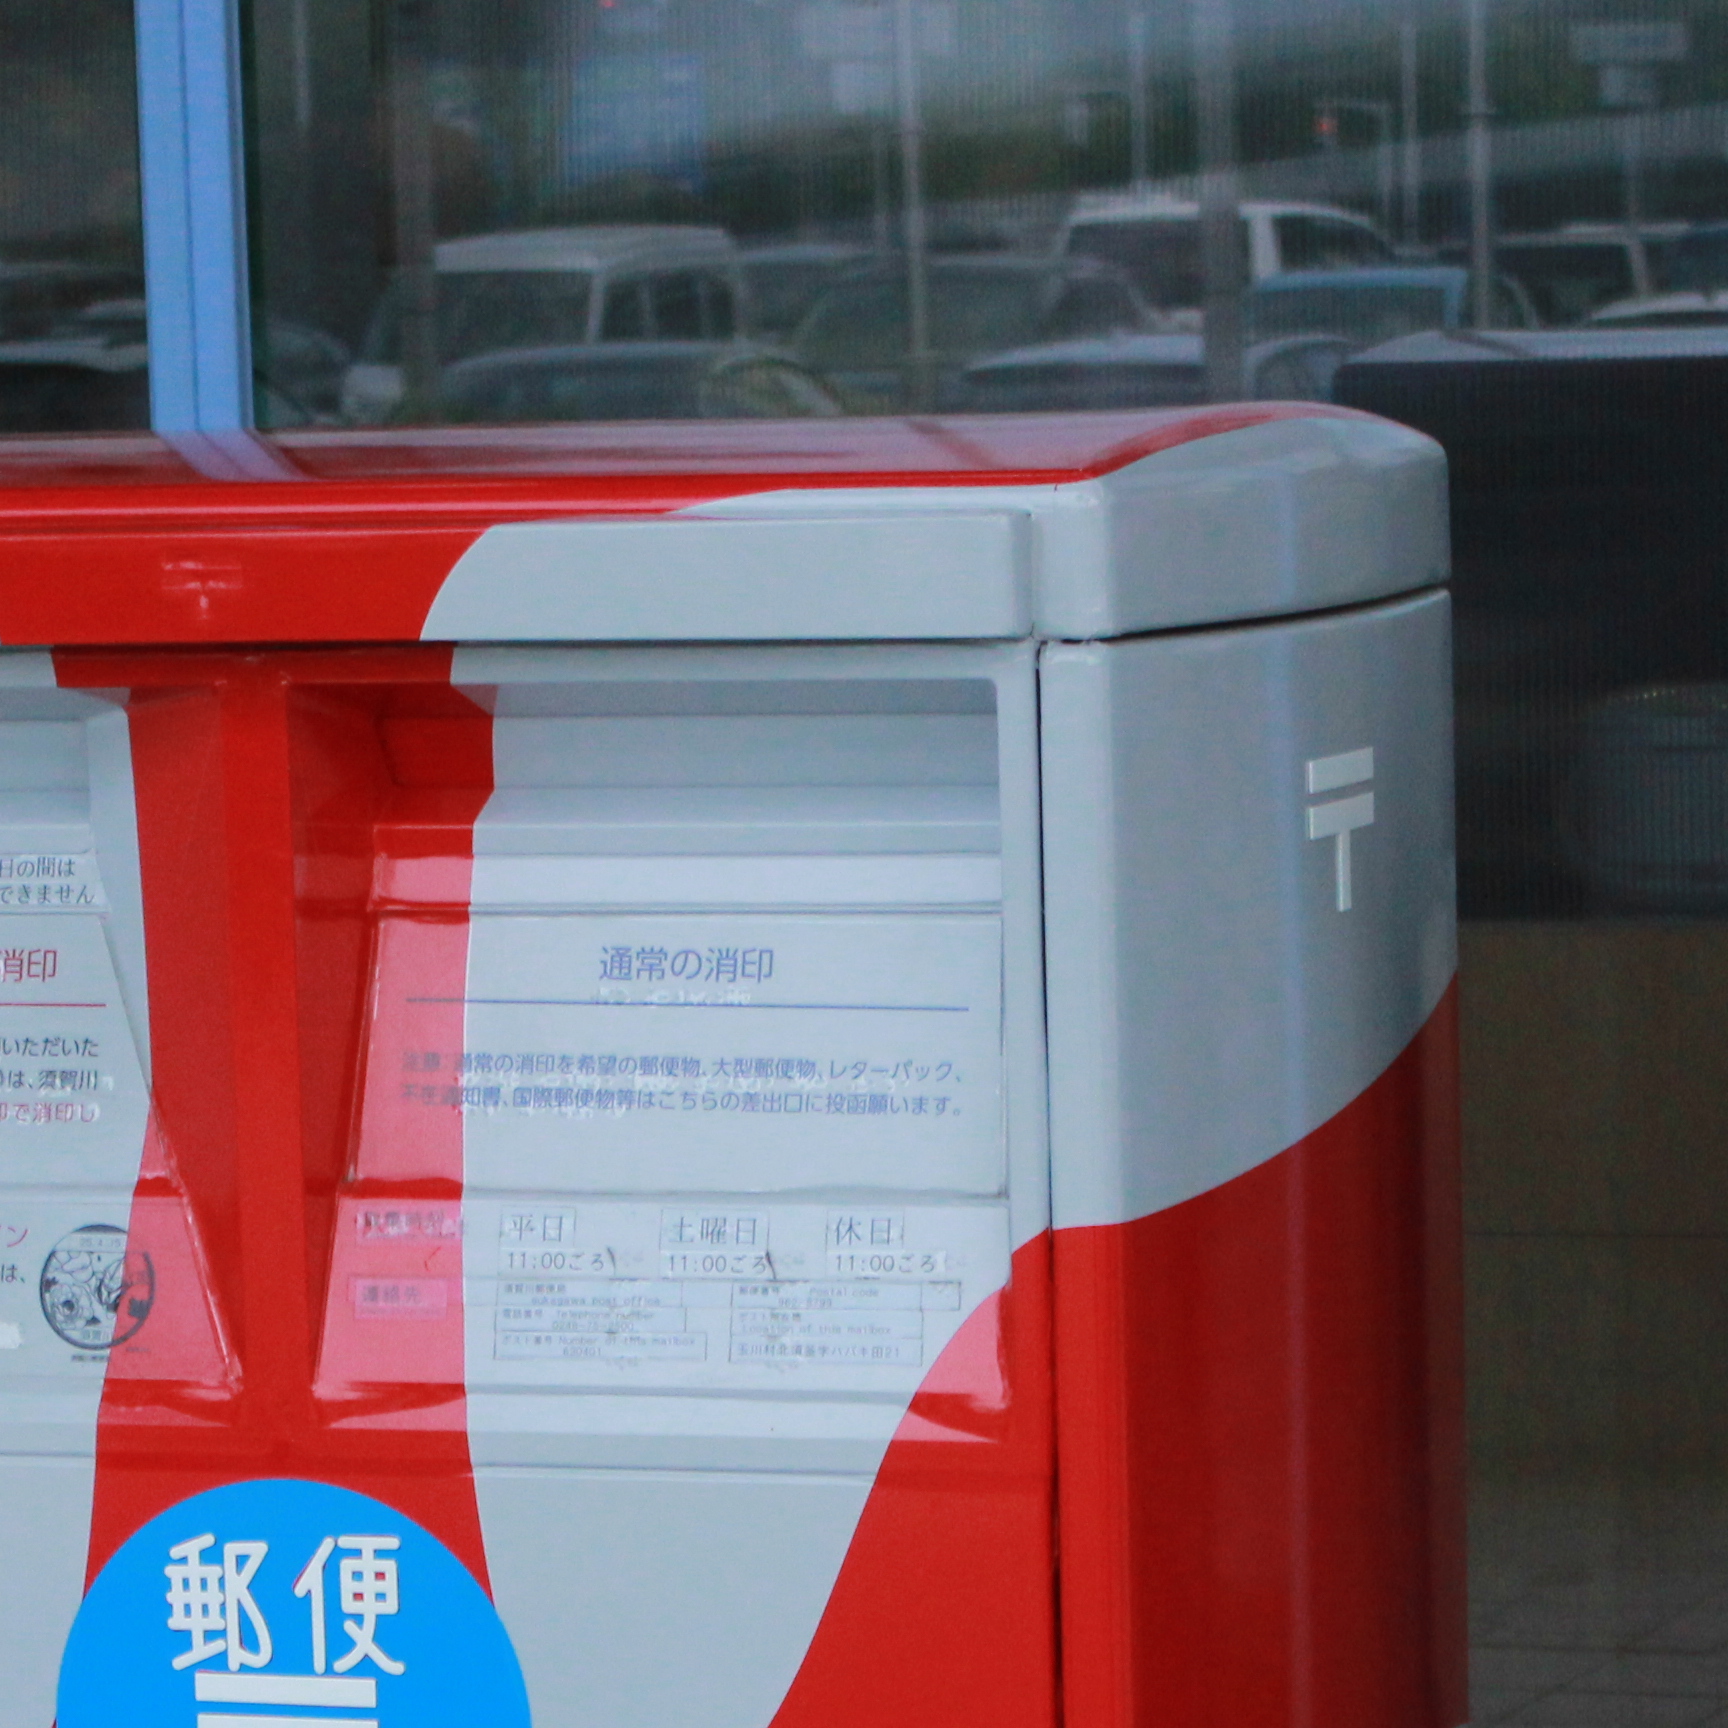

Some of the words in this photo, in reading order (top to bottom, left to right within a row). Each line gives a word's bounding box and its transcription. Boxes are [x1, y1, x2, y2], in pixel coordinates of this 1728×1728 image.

[600, 946, 773, 983] 通常の消印
[508, 1214, 565, 1243] 平日
[668, 1216, 757, 1245] 土曜日
[836, 1216, 892, 1246] 休日
[508, 1252, 606, 1272] 11:00ごろ
[669, 1254, 766, 1274] 11:00ごろ
[836, 1254, 936, 1274] 11:00ごろ
[163, 1533, 406, 1676] 郵便
